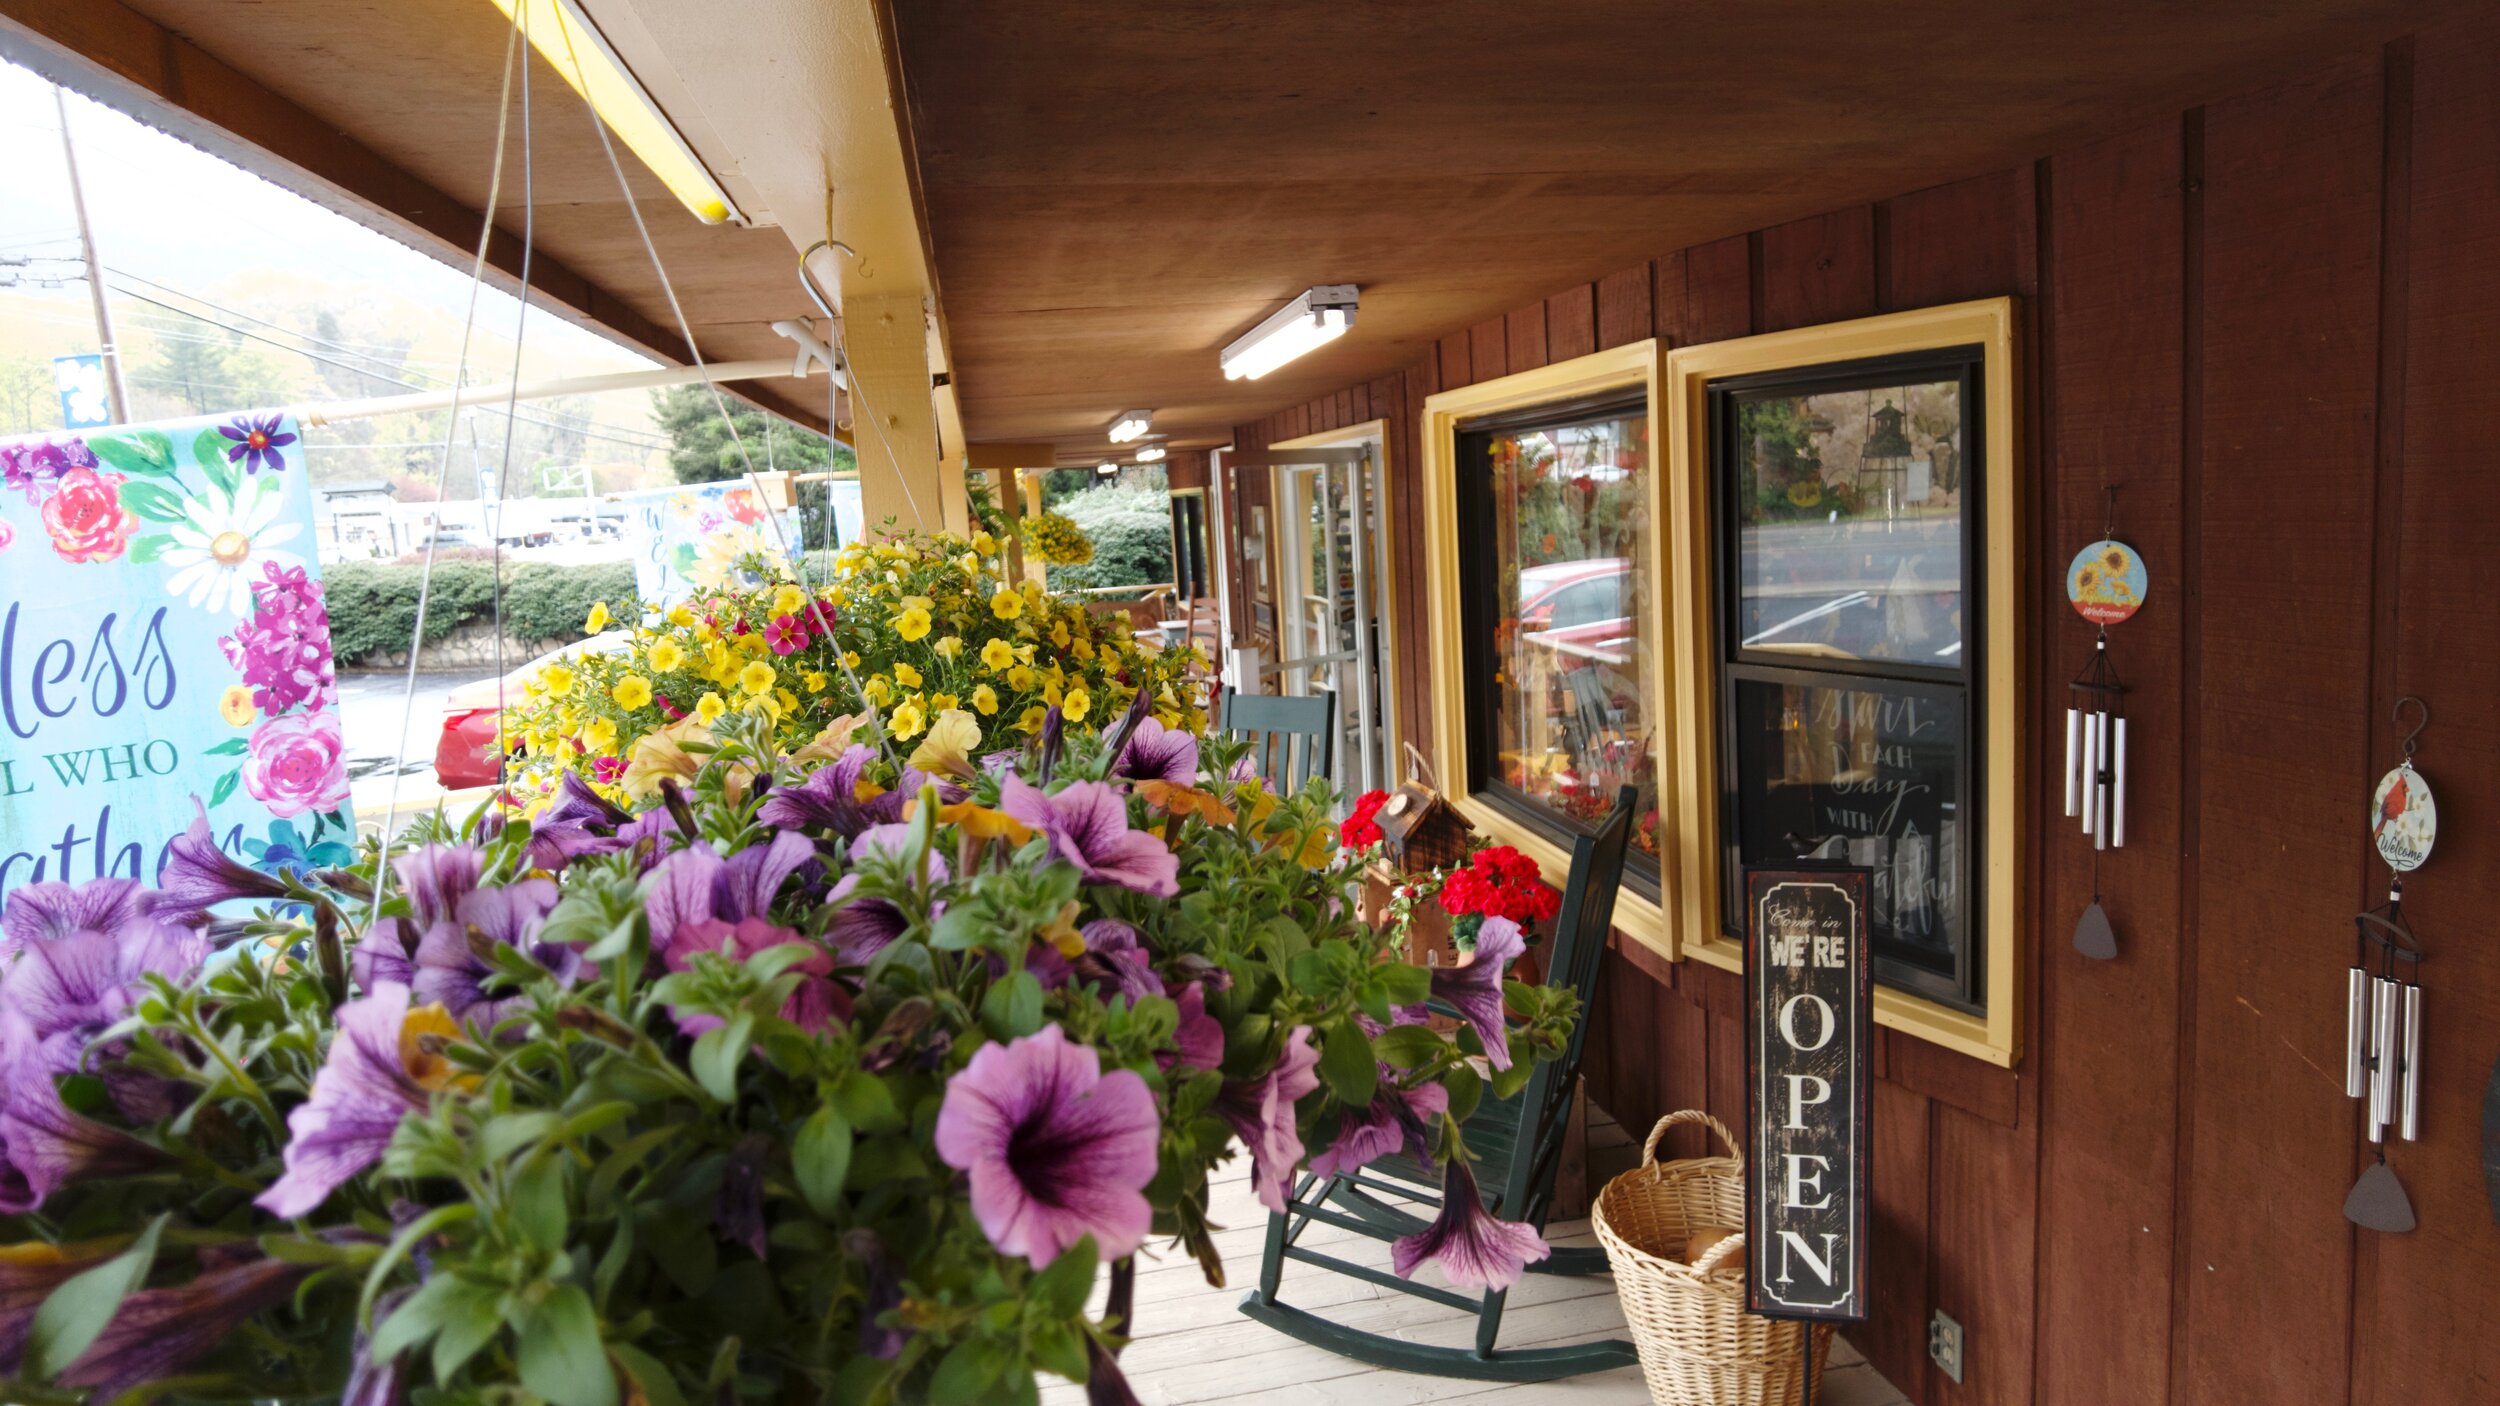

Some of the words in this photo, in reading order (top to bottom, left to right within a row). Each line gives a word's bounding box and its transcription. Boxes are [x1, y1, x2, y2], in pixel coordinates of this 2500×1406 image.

[2083, 607, 2126, 618] Welcome
[42, 739, 178, 788] WHO
[1861, 741, 1912, 769] EACH
[1828, 740, 1930, 840] Day
[1826, 806, 1873, 833] WITH
[2377, 833, 2424, 866] Welcome
[1768, 902, 1816, 929] Come
[1822, 916, 1843, 929] in
[1768, 933, 1846, 969] WE'RE
[1775, 993, 1839, 1287] OPEN
